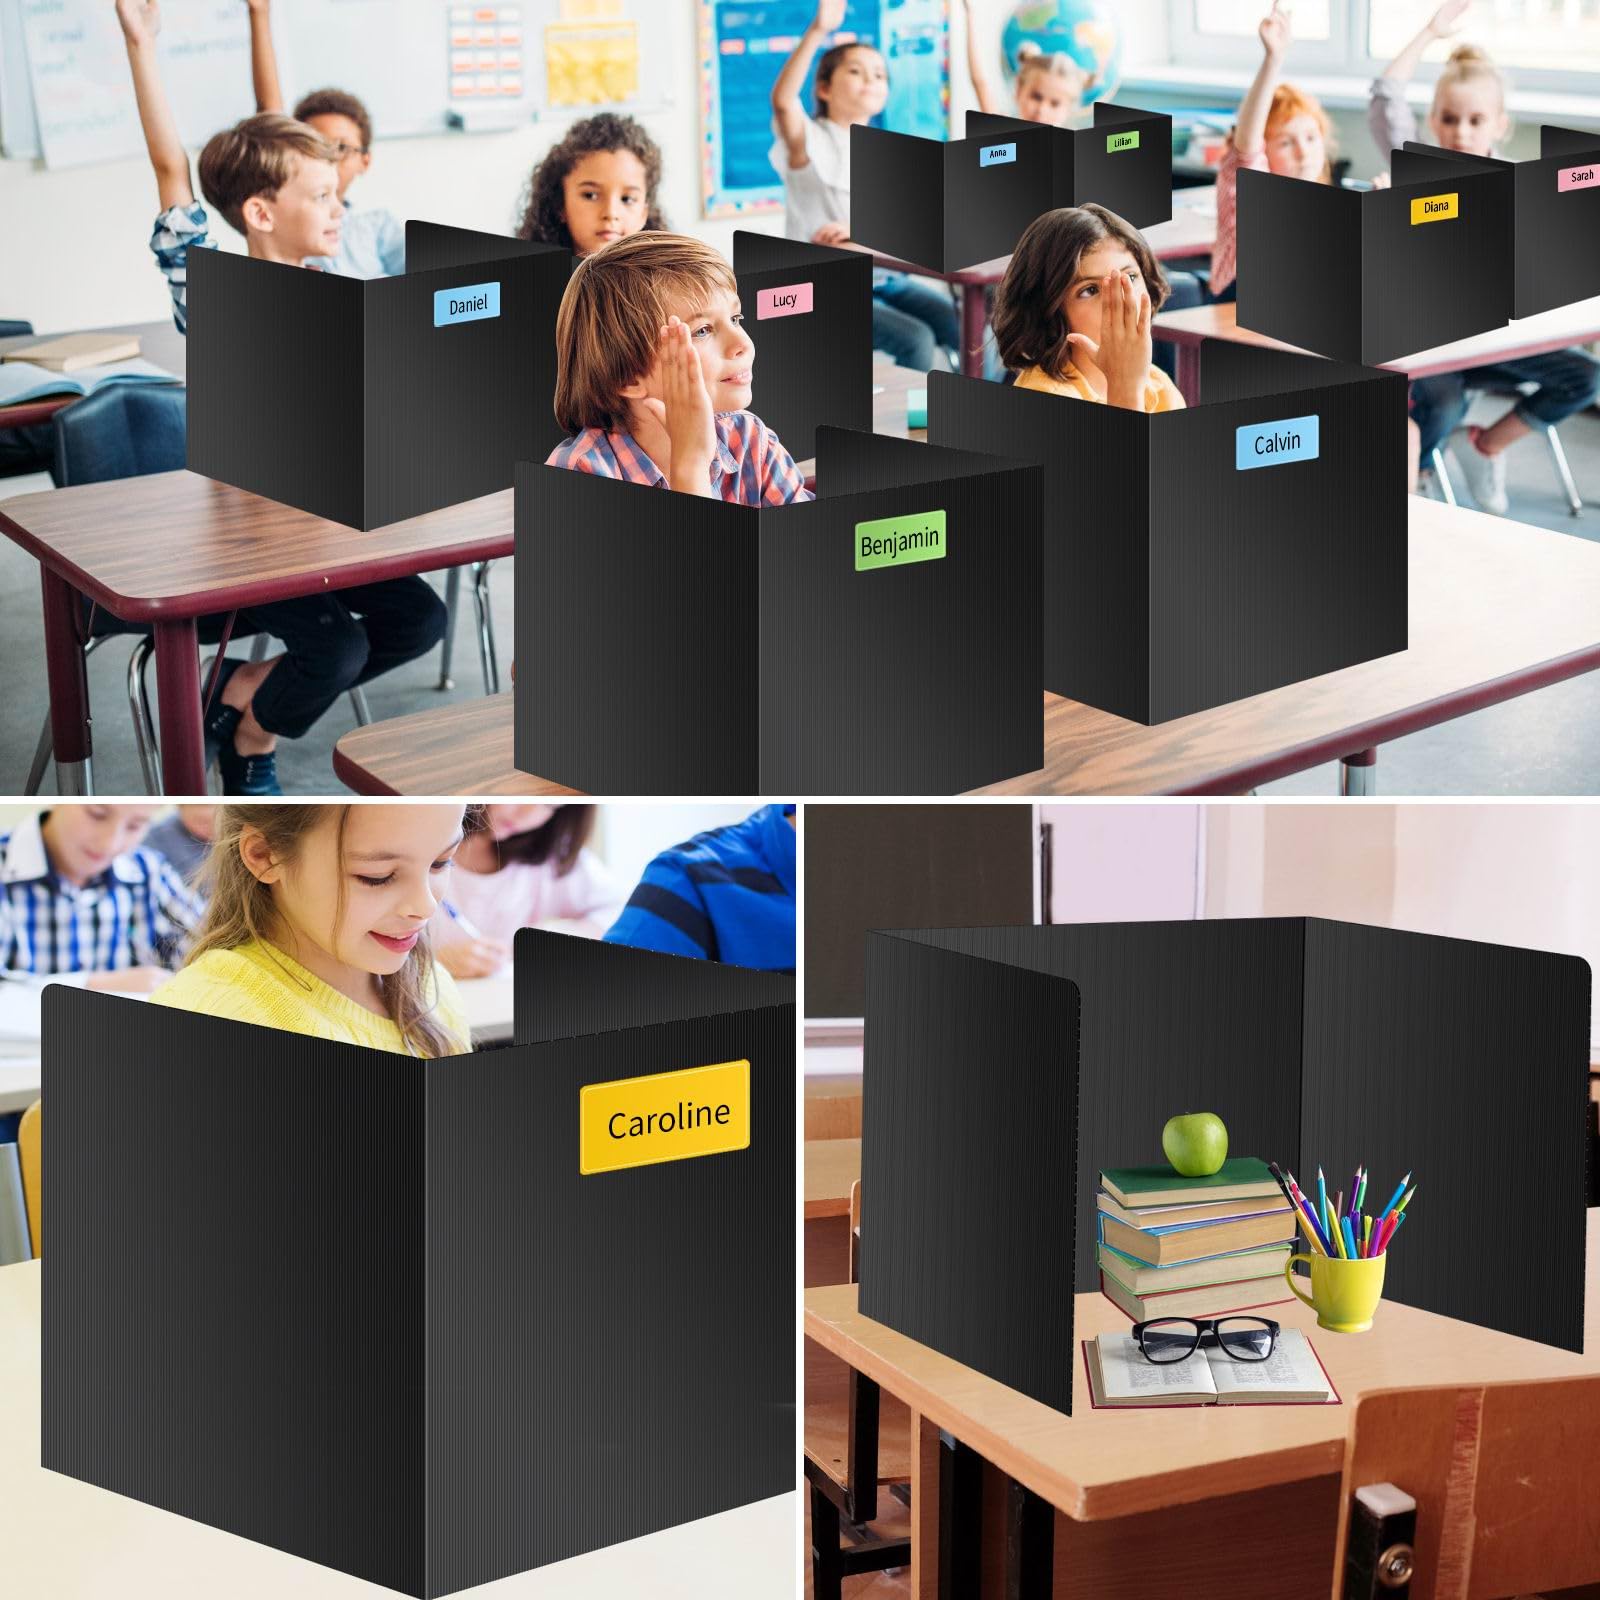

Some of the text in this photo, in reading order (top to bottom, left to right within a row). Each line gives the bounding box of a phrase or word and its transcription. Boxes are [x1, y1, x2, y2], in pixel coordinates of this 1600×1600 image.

[1114, 136, 1132, 148] Lillian
[989, 148, 1008, 159] Anna
[1571, 168, 1594, 183] Sarah
[1423, 200, 1449, 214] Diana
[449, 293, 488, 316] Daniel
[773, 293, 798, 309] Lucy
[1254, 430, 1301, 455] Calvin
[861, 525, 939, 559] Benjamin
[608, 1099, 731, 1140] Caroline
